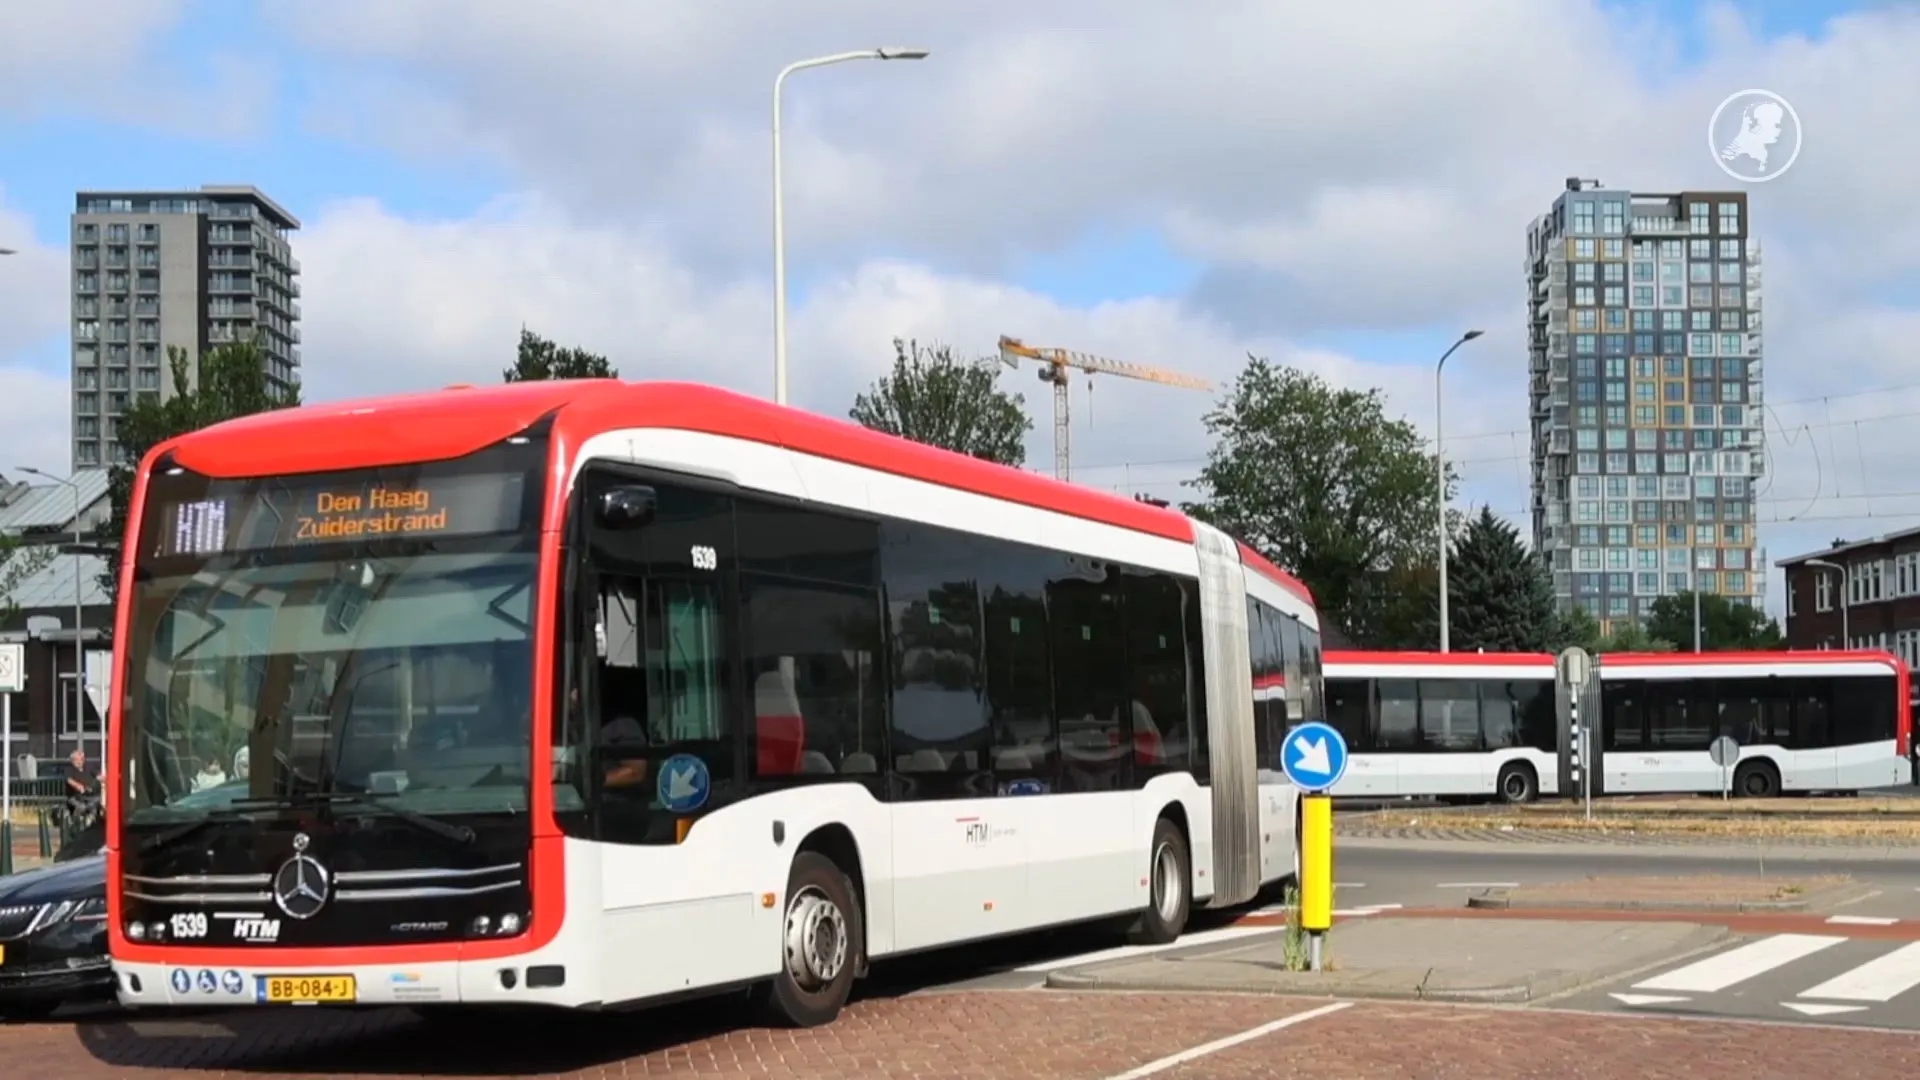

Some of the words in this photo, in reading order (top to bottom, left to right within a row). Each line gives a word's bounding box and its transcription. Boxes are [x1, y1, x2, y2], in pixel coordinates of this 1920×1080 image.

[317, 492, 361, 513] Den
[370, 488, 429, 511] Haag
[176, 501, 225, 552] HTM
[296, 508, 446, 538] Zuiderstrand
[691, 544, 717, 570] 1539
[966, 823, 988, 843] HTM
[170, 912, 208, 938] 1539
[233, 919, 280, 938] HTM
[271, 979, 347, 997] BB-084-J
